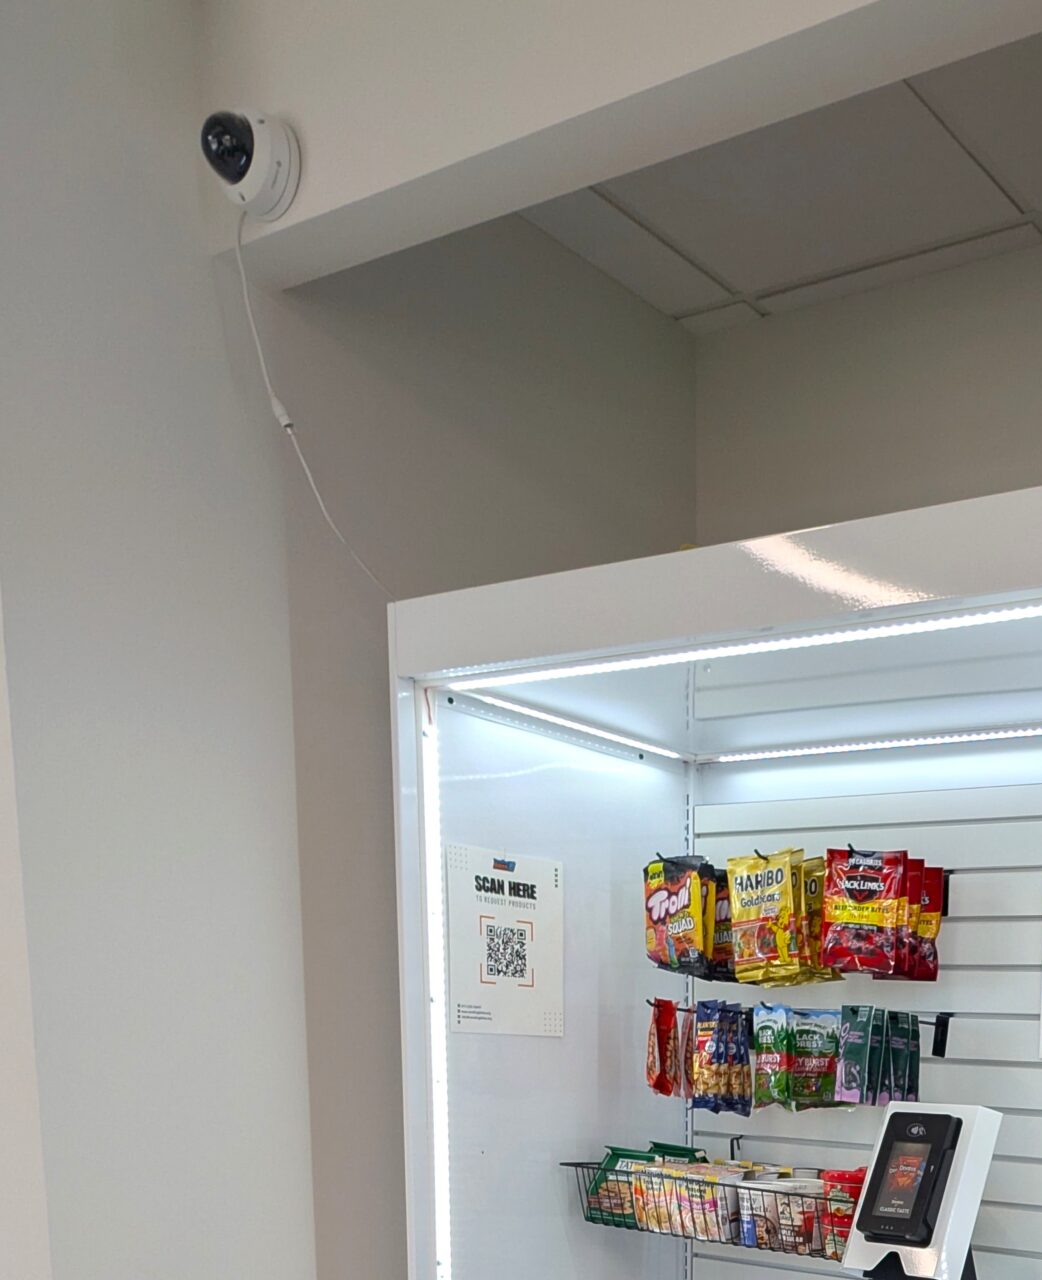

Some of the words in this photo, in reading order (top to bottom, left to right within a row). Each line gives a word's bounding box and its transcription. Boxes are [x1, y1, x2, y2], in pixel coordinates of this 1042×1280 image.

[474, 874, 505, 896] SCAN
[508, 880, 538, 900] HERE
[734, 867, 785, 893] HARIBO
[646, 877, 693, 922] Trolli
[667, 916, 695, 936] SQUAD
[796, 1034, 820, 1042] LACK
